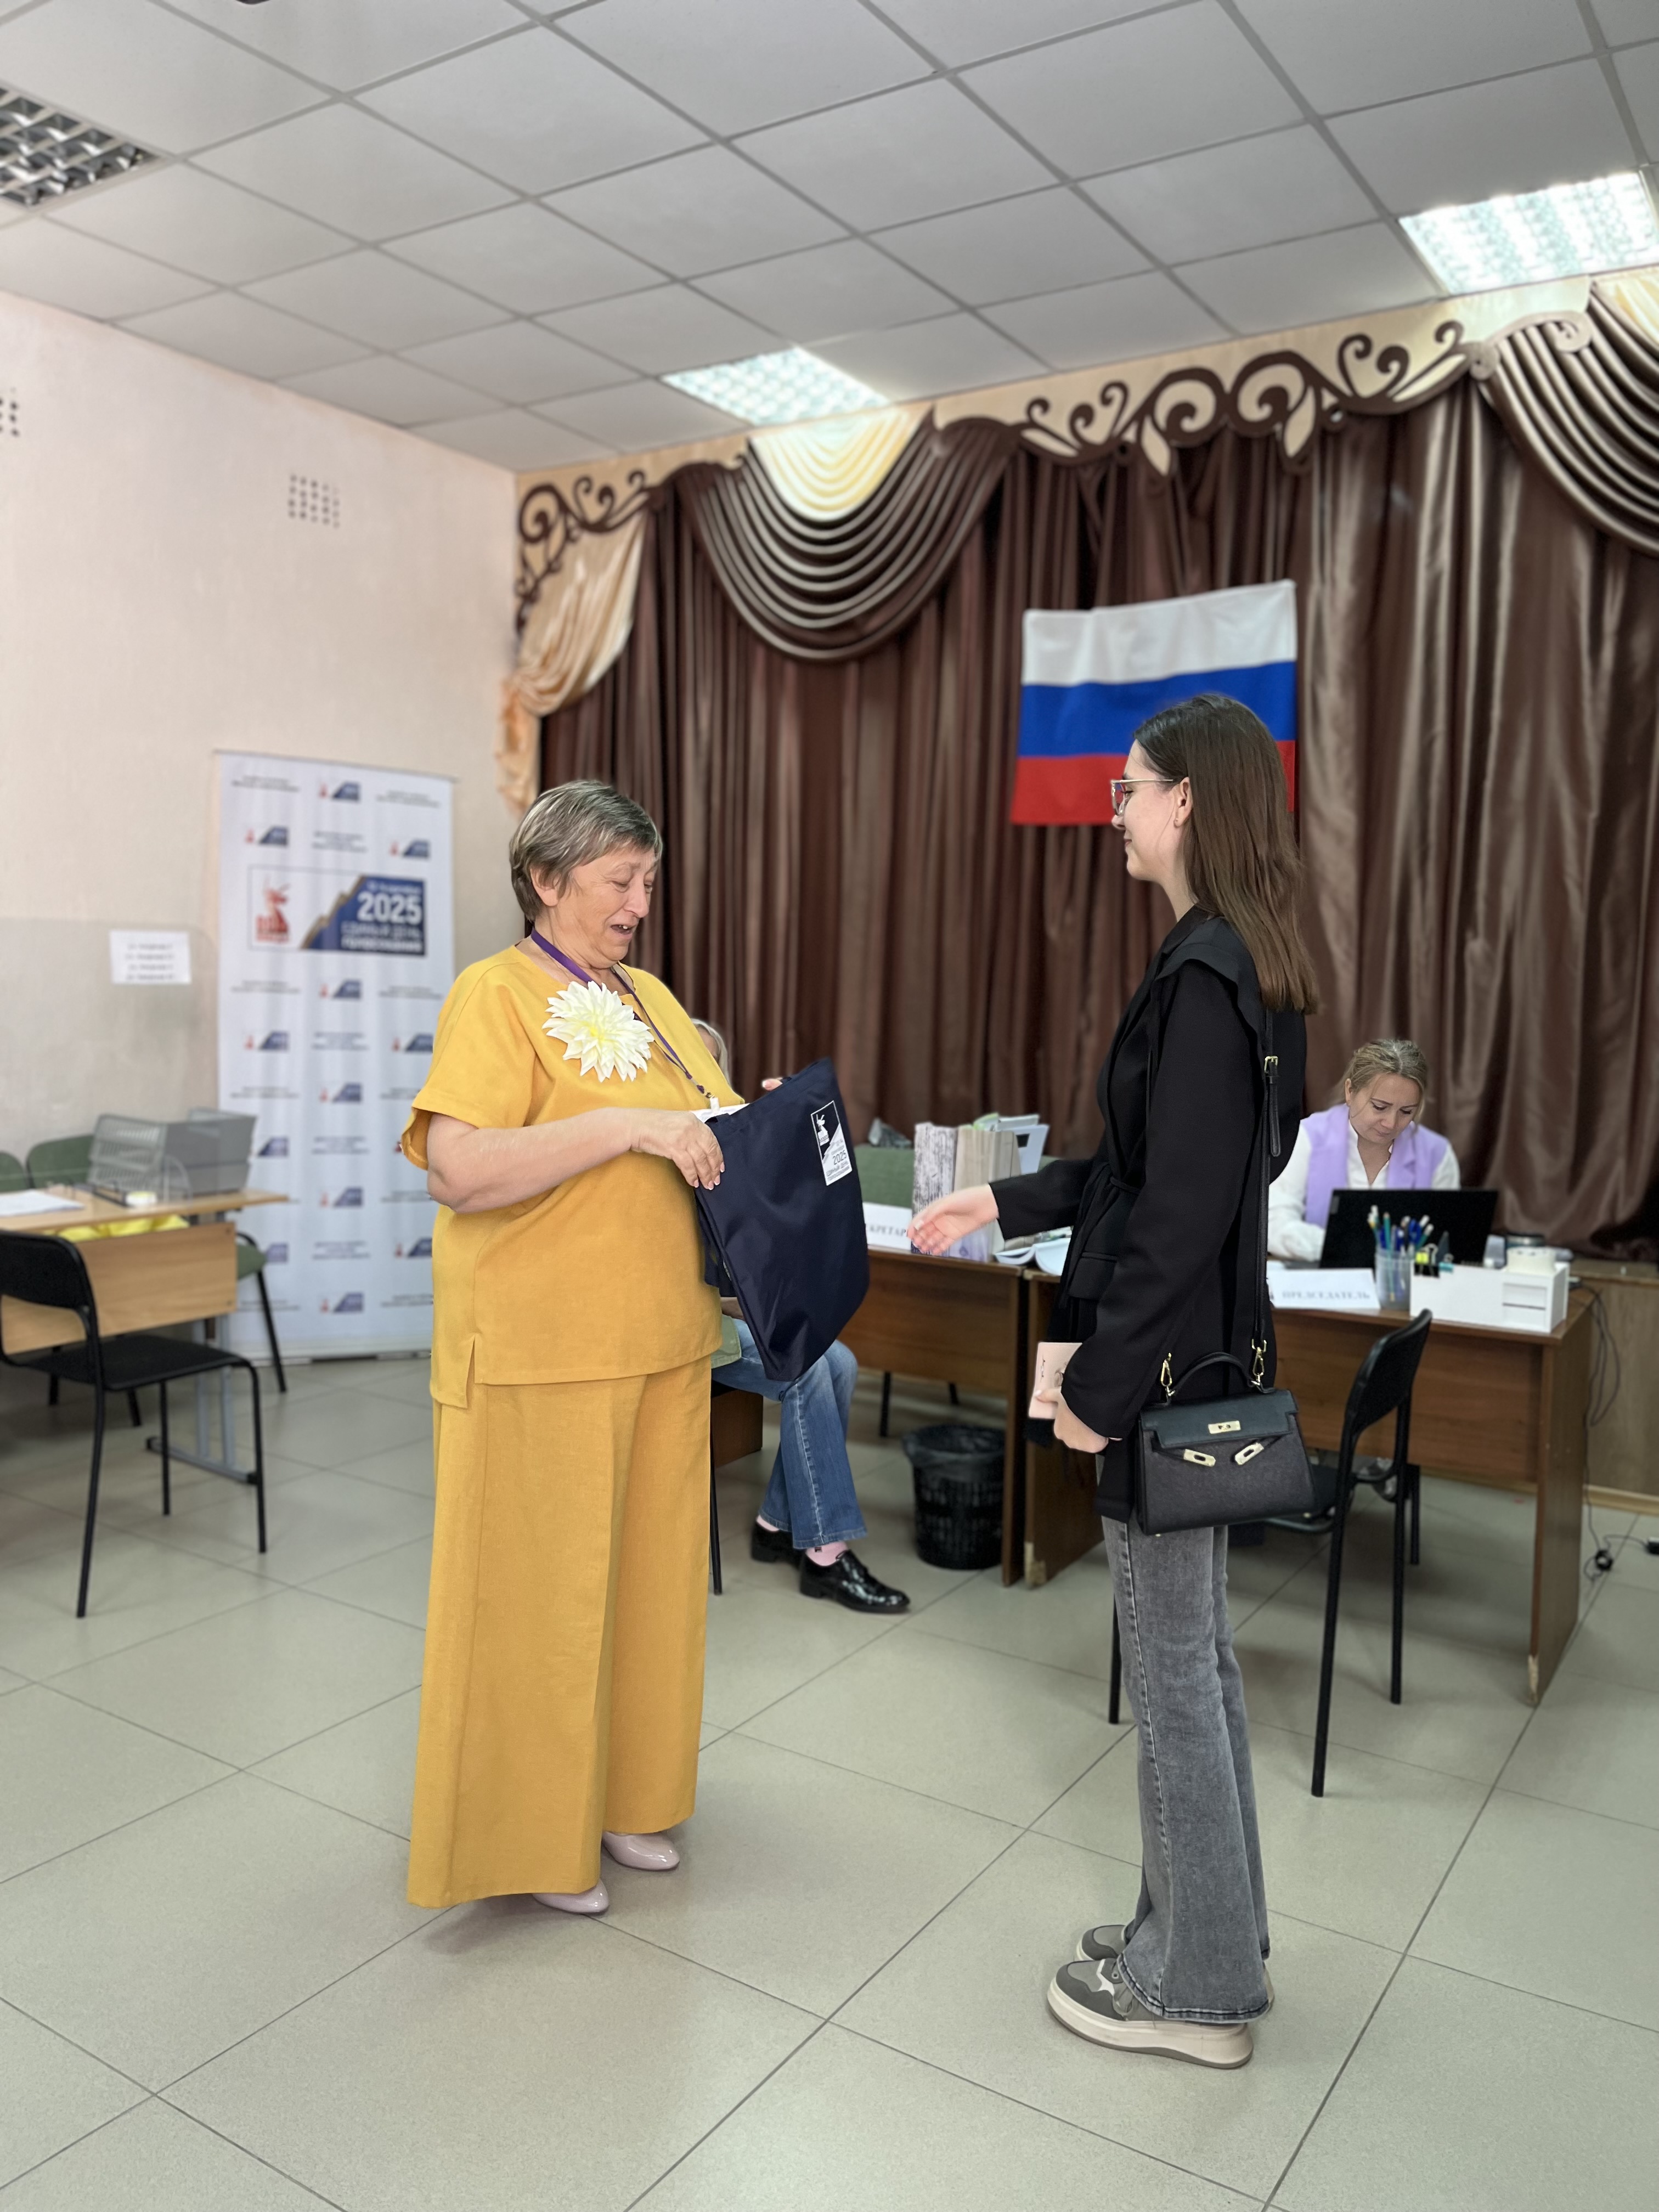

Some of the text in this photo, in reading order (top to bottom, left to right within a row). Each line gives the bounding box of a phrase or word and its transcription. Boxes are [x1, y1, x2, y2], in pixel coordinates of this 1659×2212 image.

[357, 890, 422, 926] 2025
[833, 1149, 847, 1165] 2025
[869, 1223, 909, 1238] КРЕТАР
